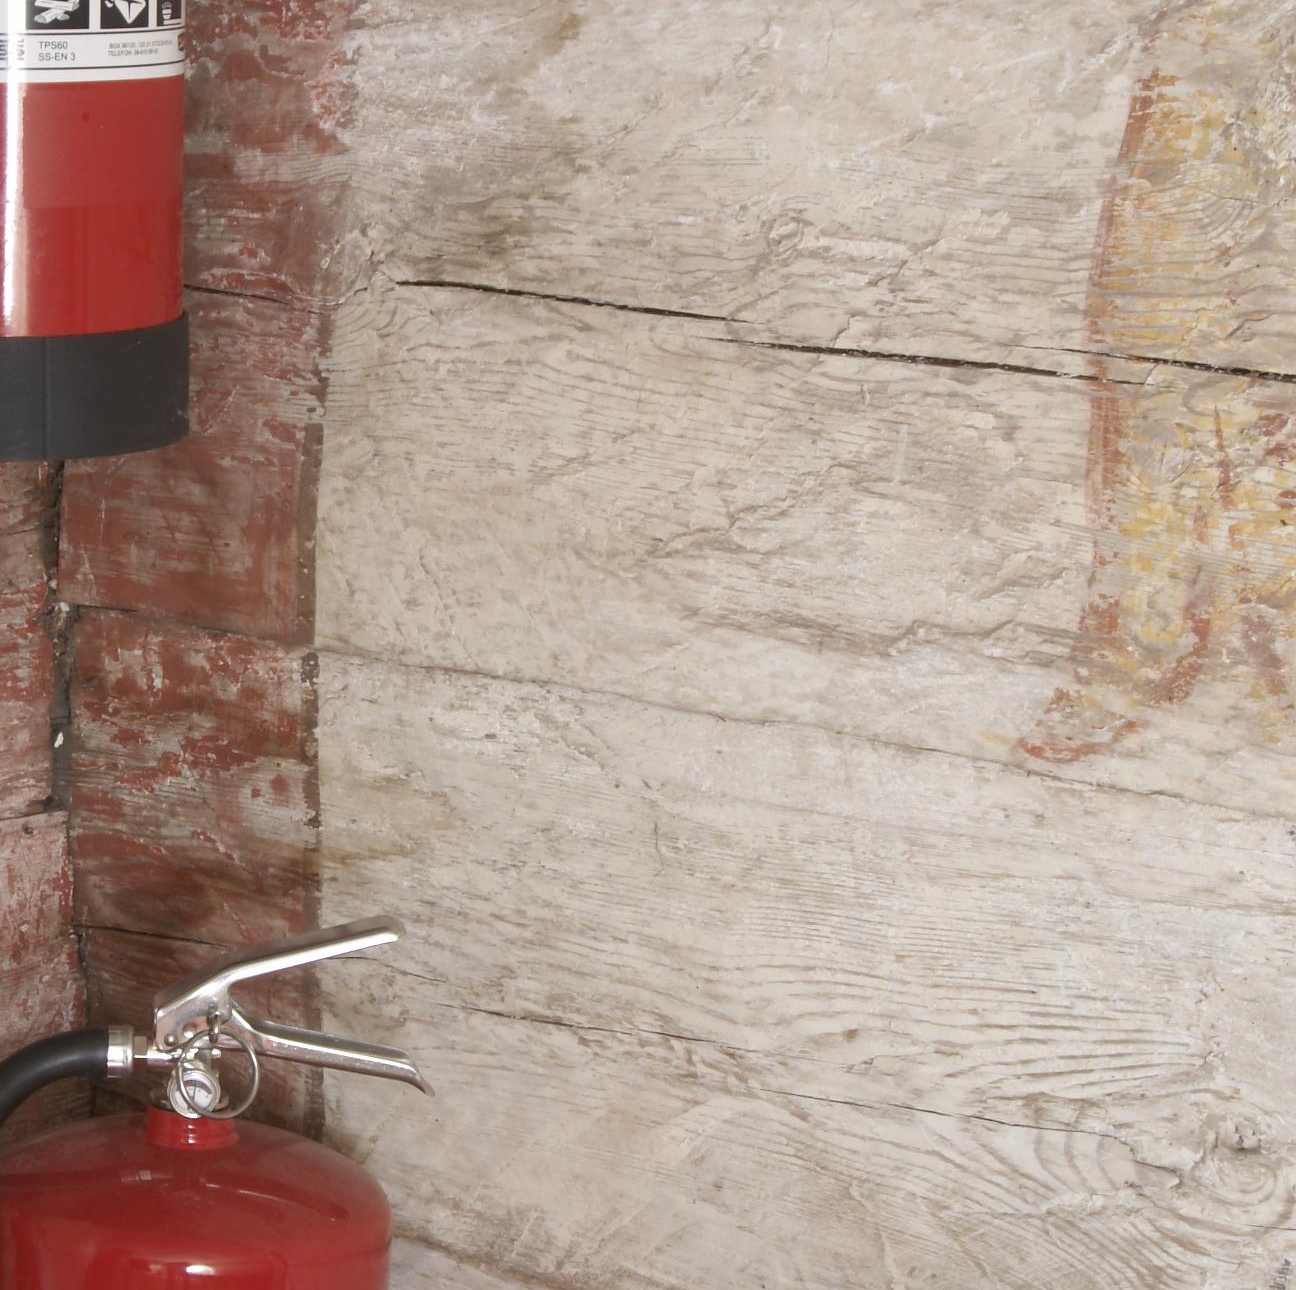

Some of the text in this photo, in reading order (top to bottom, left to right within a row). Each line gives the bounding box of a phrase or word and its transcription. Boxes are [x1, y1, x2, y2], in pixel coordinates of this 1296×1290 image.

[38, 40, 68, 50] TPS60
[38, 52, 76, 61] SS-EN 3
